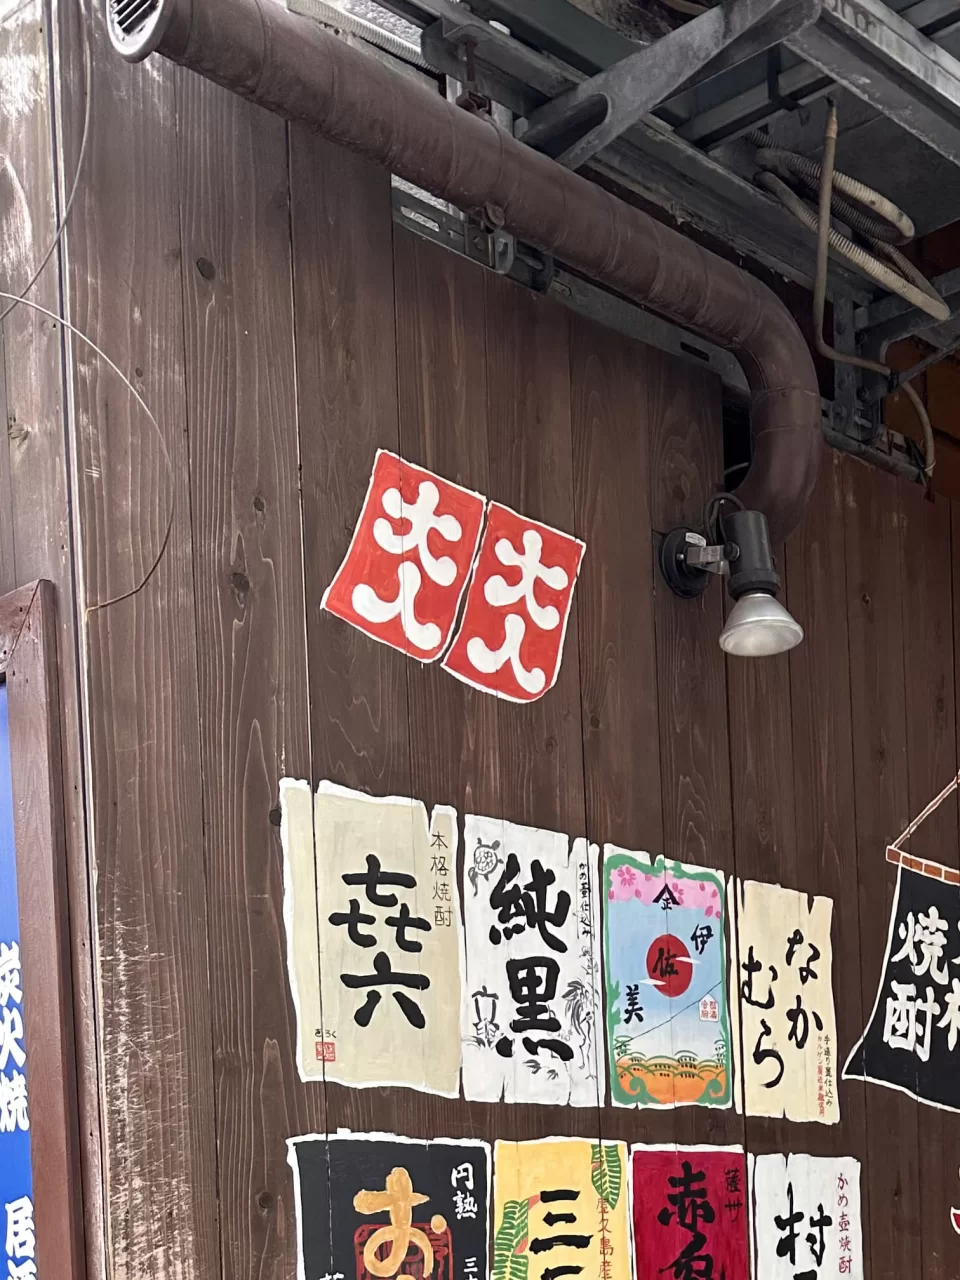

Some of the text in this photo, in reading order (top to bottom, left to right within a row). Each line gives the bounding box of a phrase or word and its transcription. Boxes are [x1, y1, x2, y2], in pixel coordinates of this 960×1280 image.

[489, 853, 574, 1061] 純黒
[882, 907, 950, 1061] 焼酎
[451, 1162, 478, 1219] 円熟
